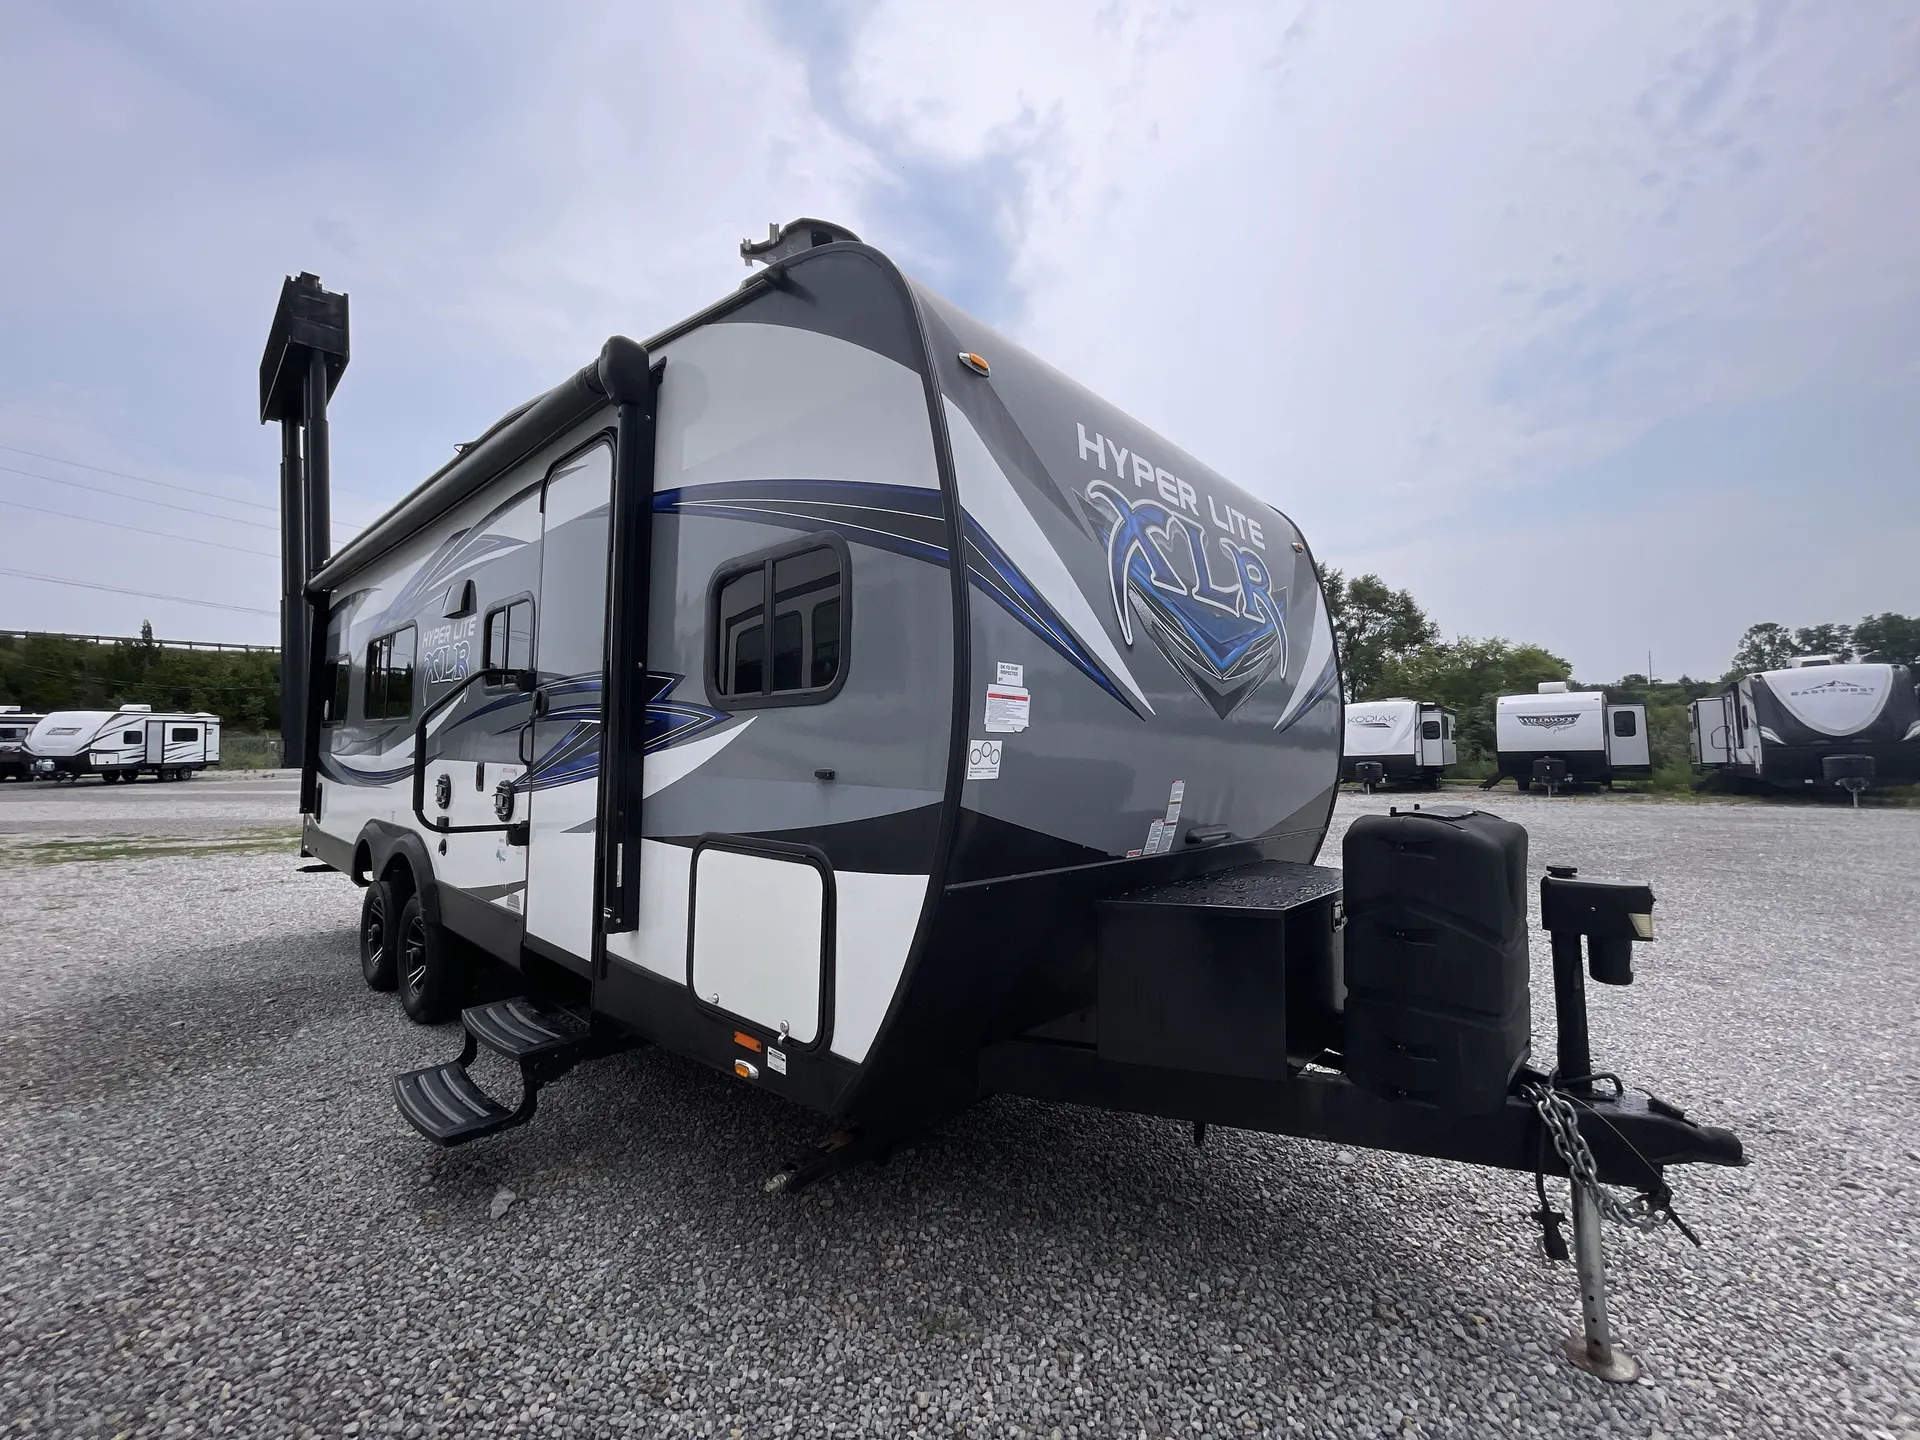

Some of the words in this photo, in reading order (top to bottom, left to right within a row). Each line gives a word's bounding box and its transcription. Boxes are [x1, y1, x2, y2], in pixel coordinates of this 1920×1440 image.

[1077, 422, 1200, 516] HYPER
[1208, 495, 1266, 550] LITE
[1085, 479, 1288, 679] XLR
[422, 624, 452, 648] HYPER
[453, 616, 477, 640] LITE
[423, 640, 470, 706] XLR
[1347, 714, 1398, 724] KODIAK
